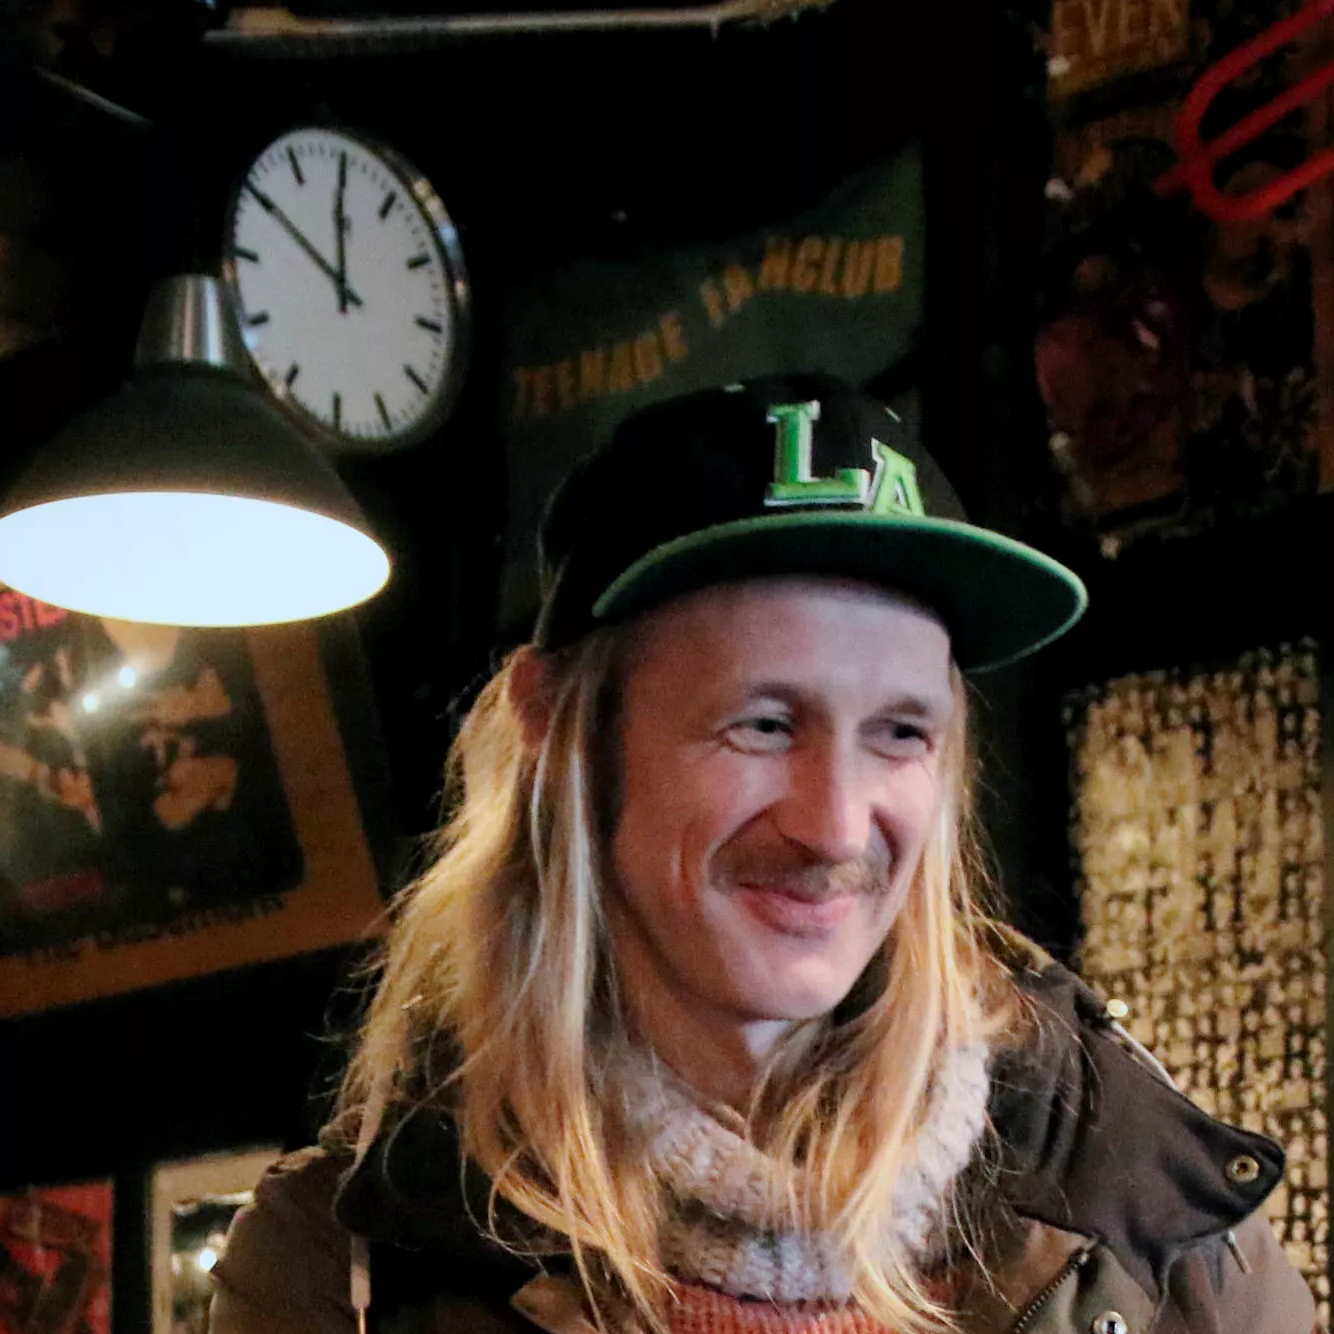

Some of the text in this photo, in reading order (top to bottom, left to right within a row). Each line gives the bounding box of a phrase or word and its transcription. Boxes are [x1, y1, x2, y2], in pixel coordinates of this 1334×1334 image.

[513, 235, 904, 415] TEENAGE FANCLUB
[763, 399, 926, 517] LA
